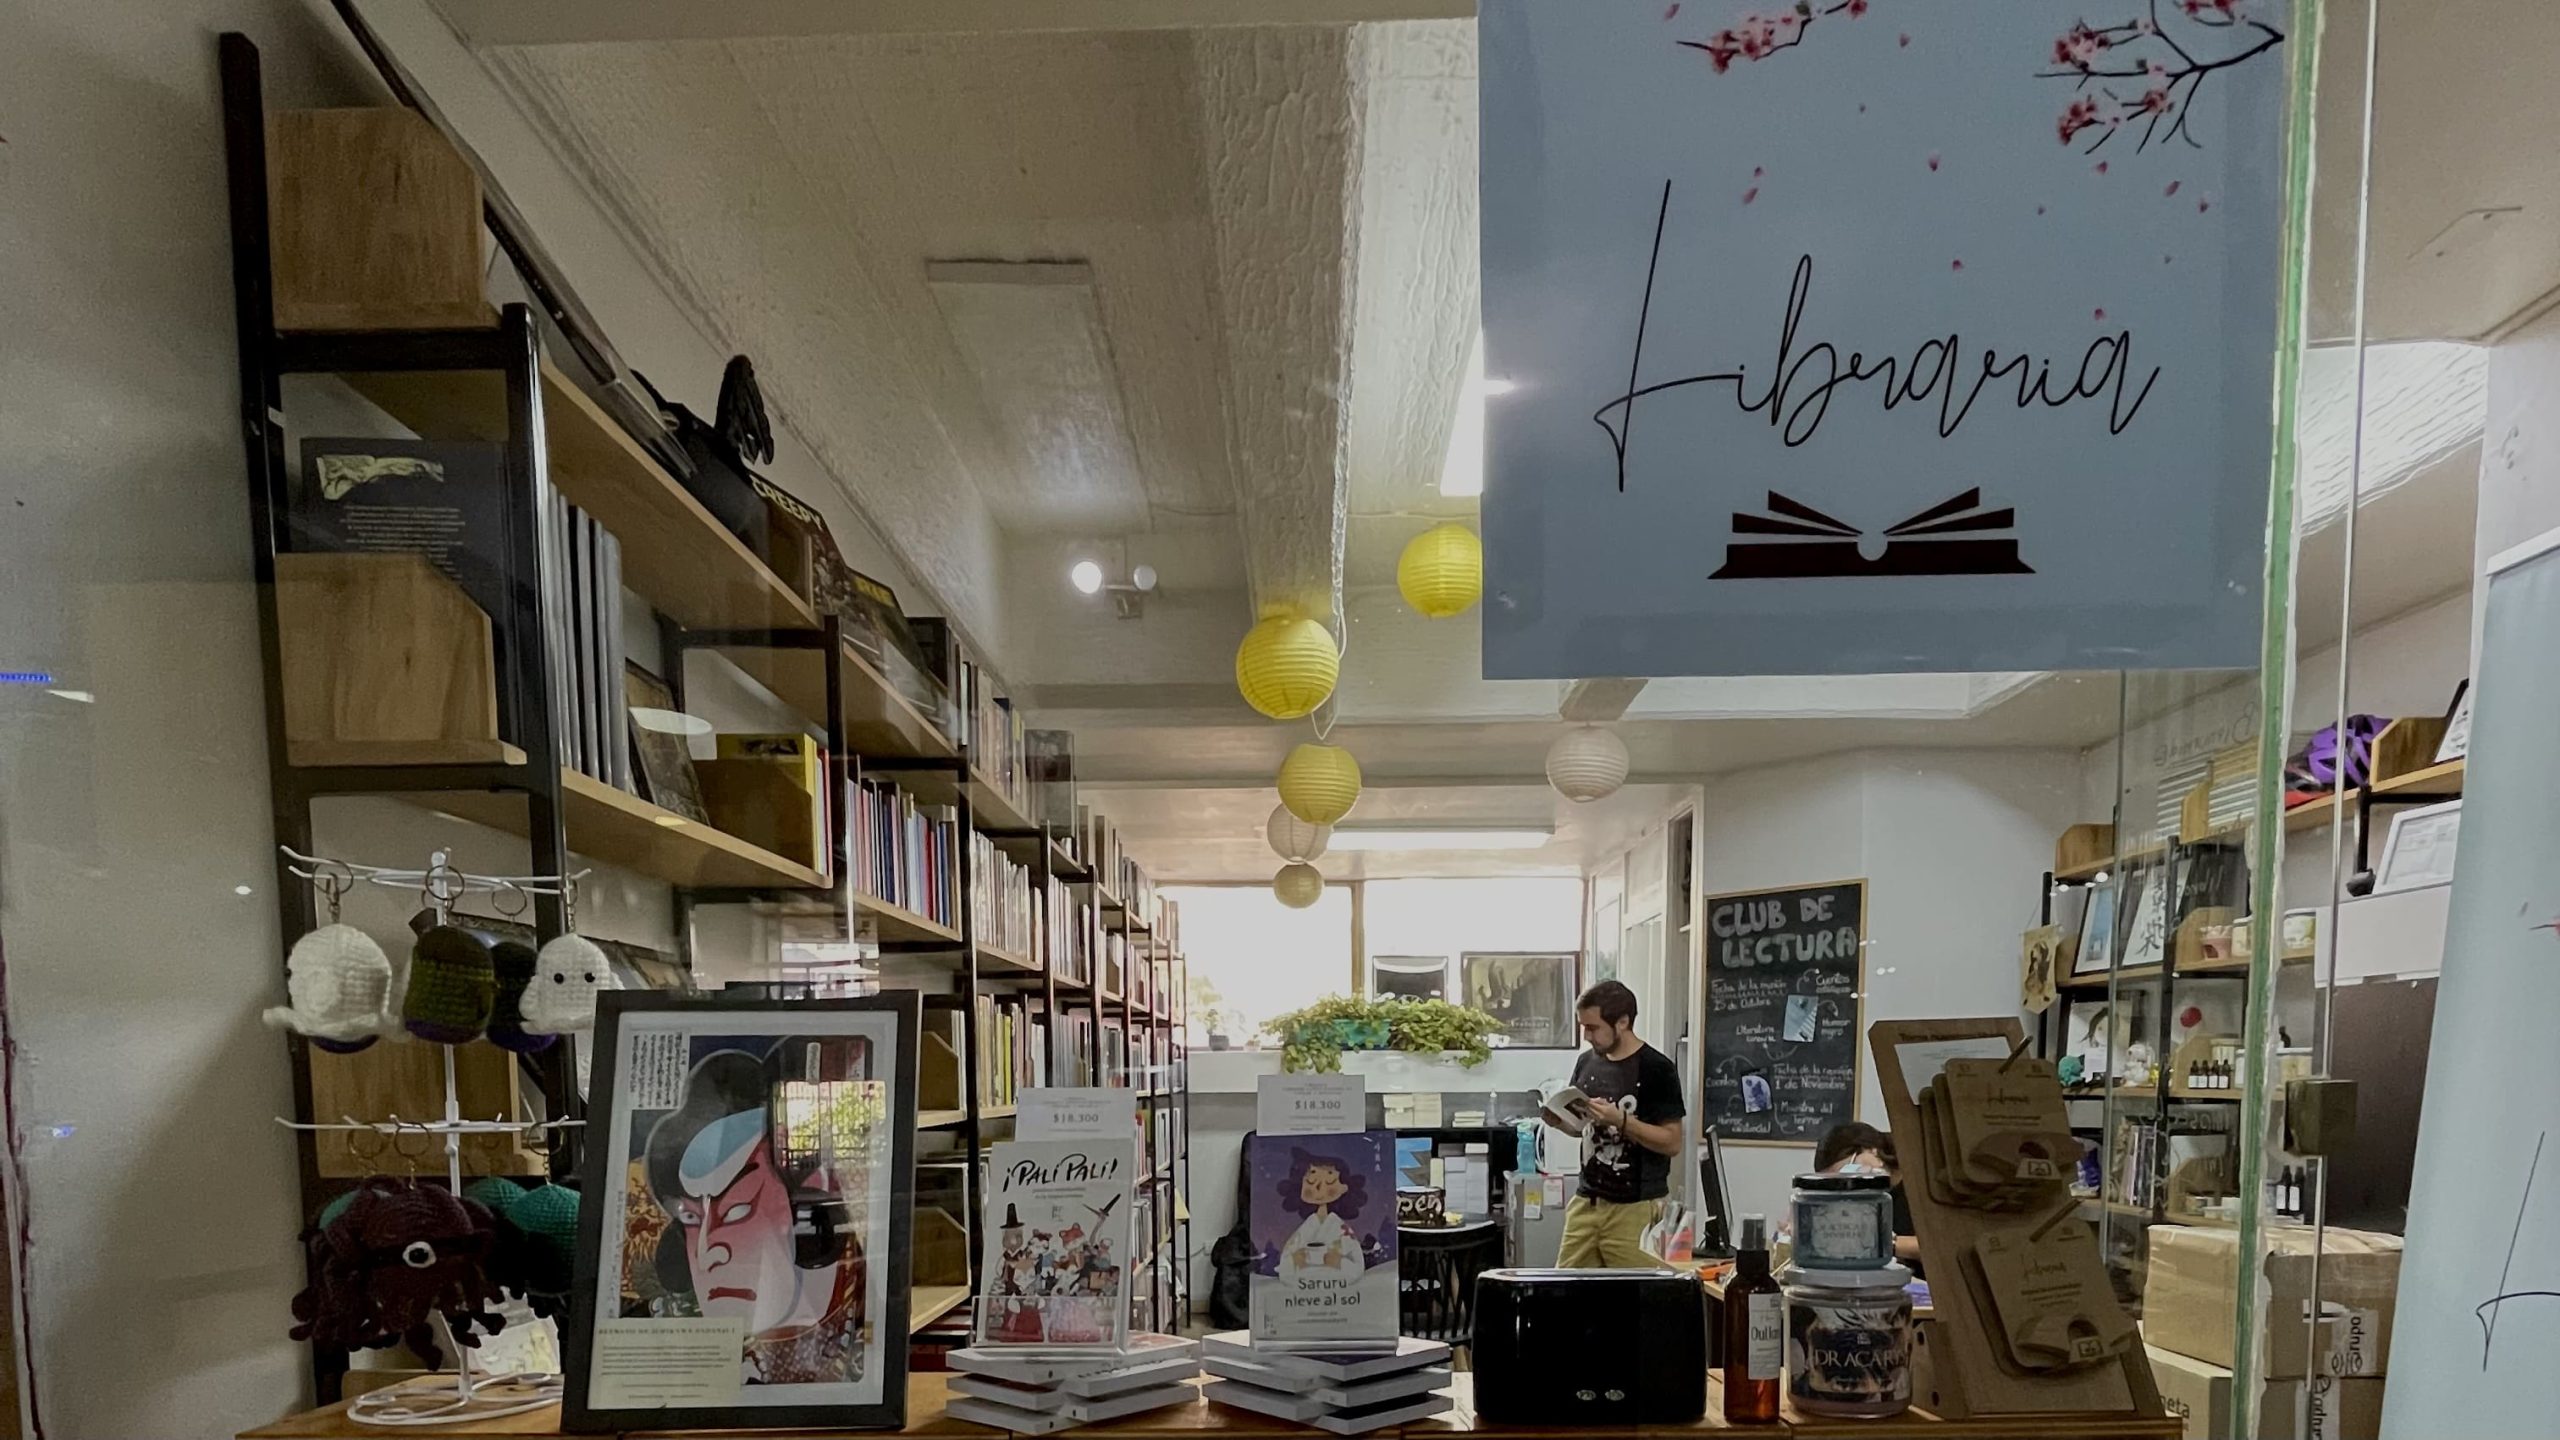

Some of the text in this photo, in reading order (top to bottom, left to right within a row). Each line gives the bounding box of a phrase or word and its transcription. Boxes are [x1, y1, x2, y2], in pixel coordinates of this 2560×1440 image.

[1593, 179, 2160, 493] Libraria
[749, 474, 823, 531] CREEPY
[1712, 894, 1836, 938] CLUB DE
[1722, 926, 1857, 968] LECTURA
[1284, 1291, 1361, 1308] nieve al sol
[1297, 1277, 1348, 1291] Saruru
